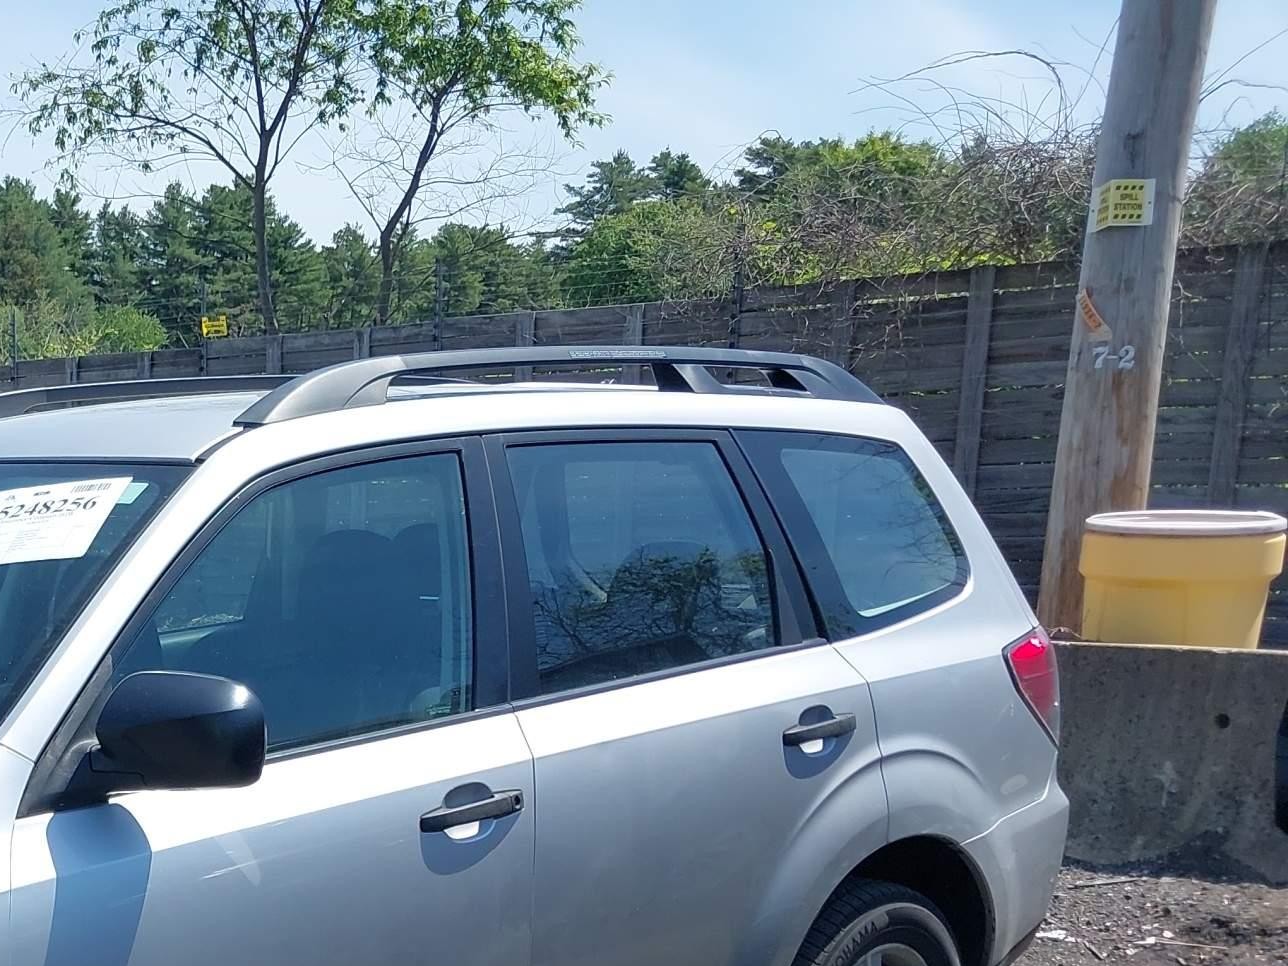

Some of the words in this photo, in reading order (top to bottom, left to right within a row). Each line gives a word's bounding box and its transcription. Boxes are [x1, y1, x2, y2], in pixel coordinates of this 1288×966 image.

[1120, 193, 1139, 201] SPILL
[1114, 203, 1143, 211] STATION
[1093, 345, 1136, 370] 7-2
